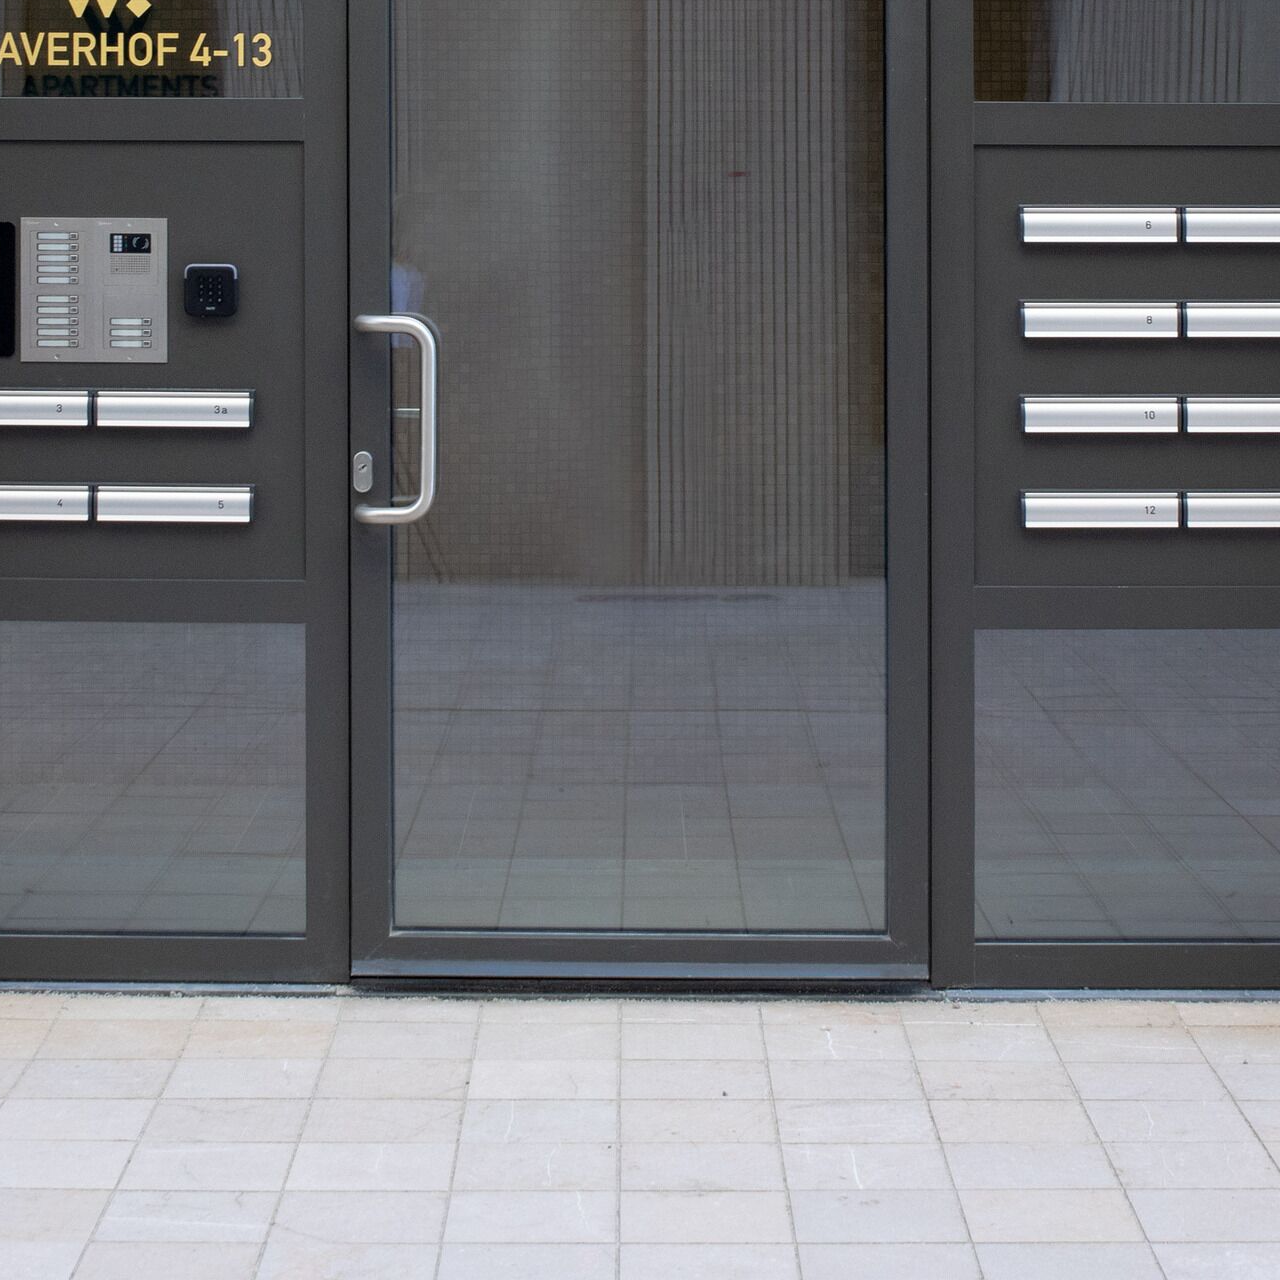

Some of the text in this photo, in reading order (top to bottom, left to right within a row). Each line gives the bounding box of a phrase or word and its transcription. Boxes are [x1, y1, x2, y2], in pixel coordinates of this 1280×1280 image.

[189, 32, 273, 67] 4-13
[1145, 220, 1152, 230] 6
[1146, 315, 1153, 325] 8
[56, 404, 63, 414] 3
[1144, 410, 1156, 420] 10
[56, 498, 63, 508] 4
[217, 499, 224, 510] 5
[1144, 505, 1156, 515] 12
